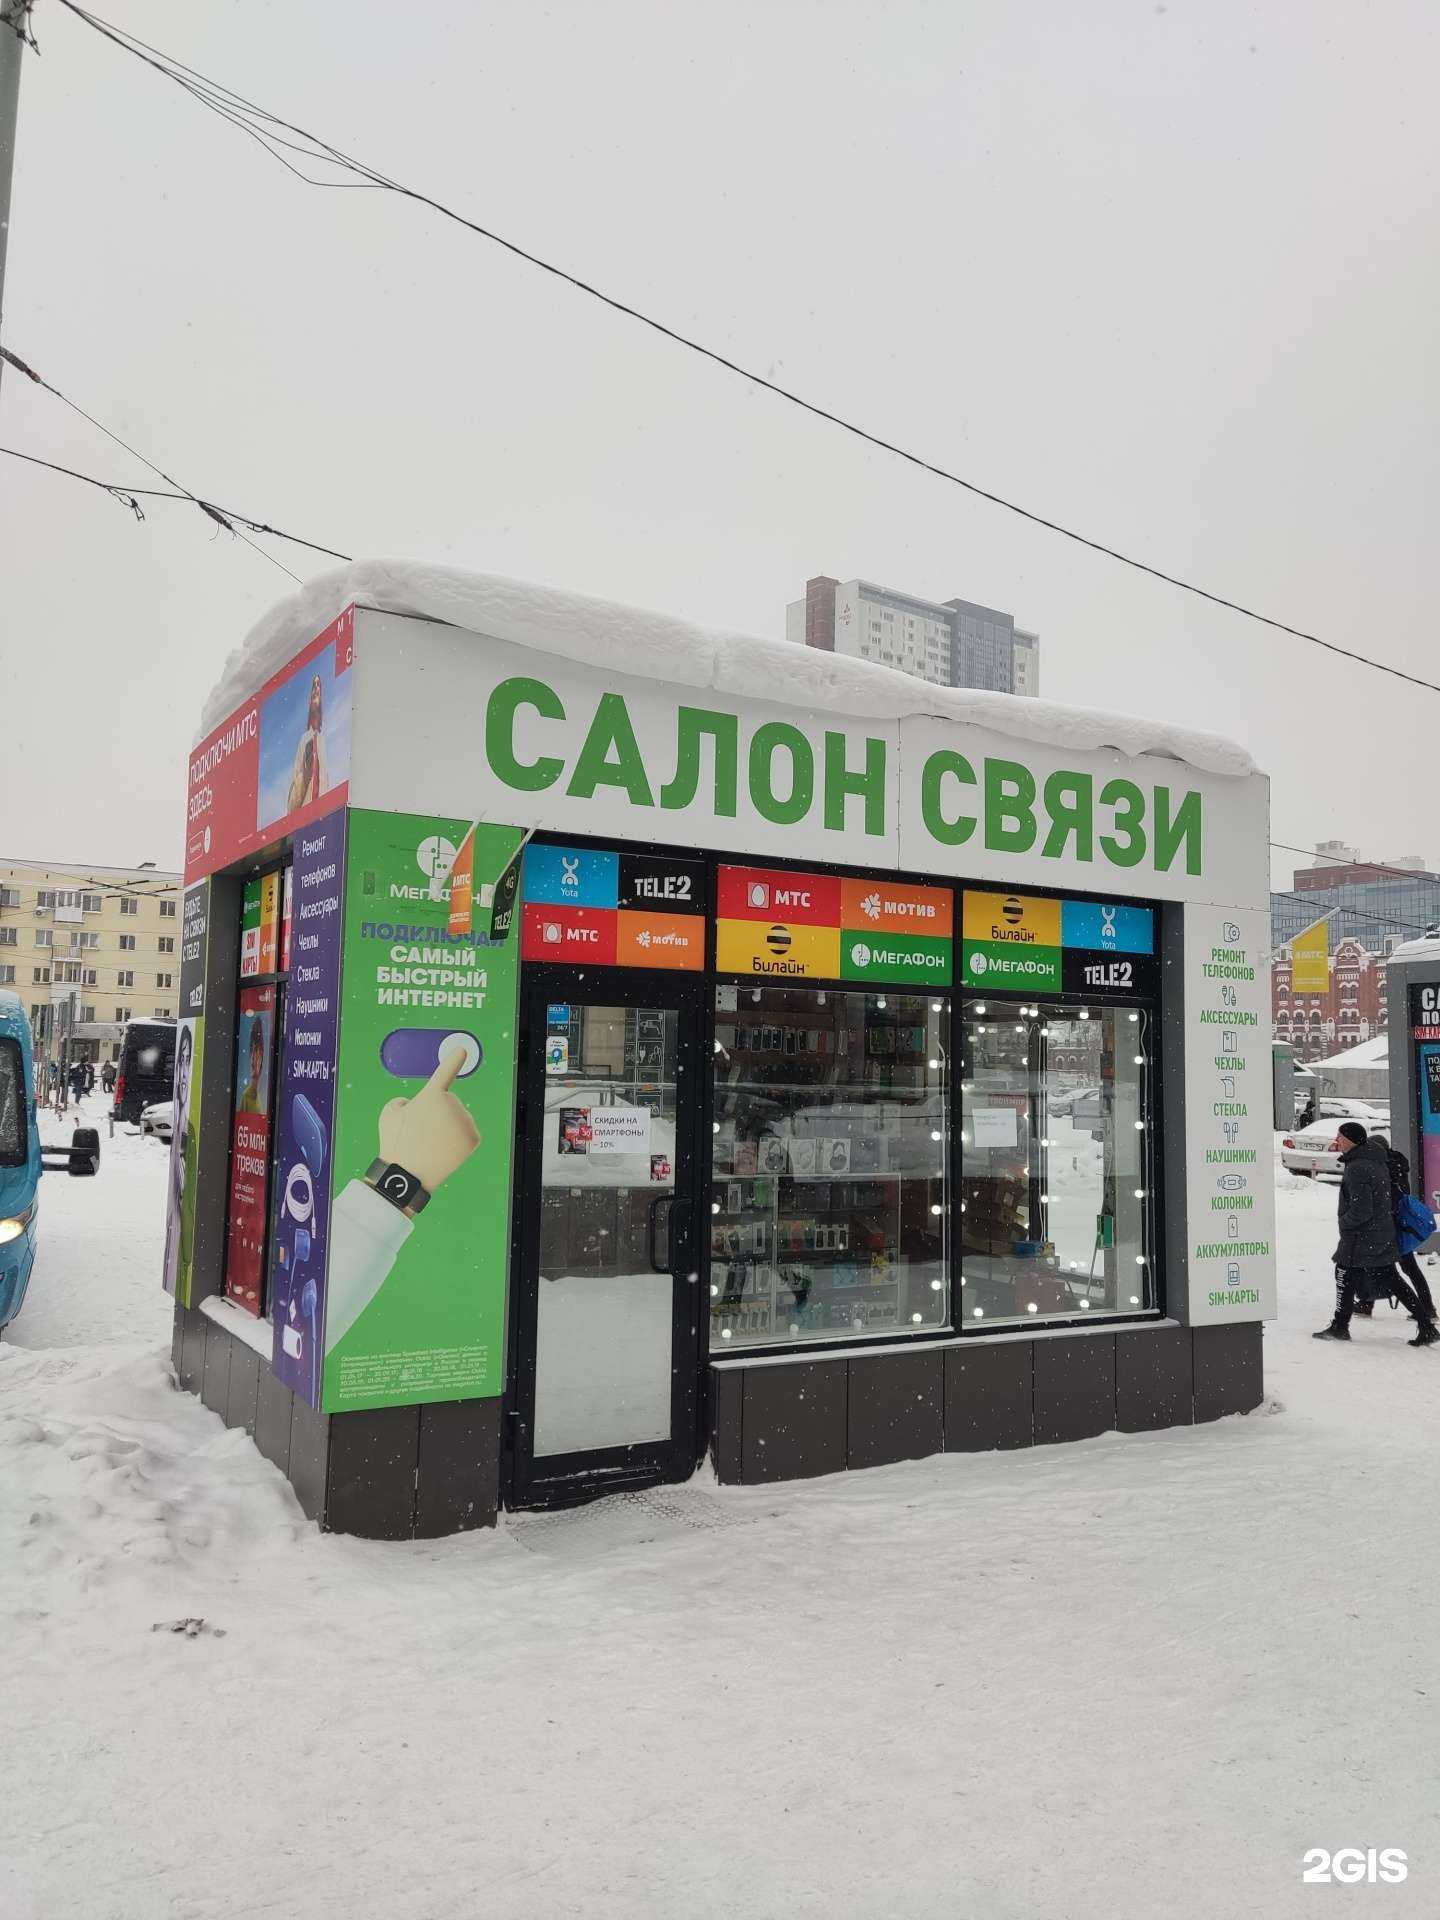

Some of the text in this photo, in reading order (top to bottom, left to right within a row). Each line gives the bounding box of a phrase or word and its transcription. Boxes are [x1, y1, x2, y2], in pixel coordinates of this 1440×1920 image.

[190, 709, 257, 785] ПОДКЛЮЧИ МТС
[485, 676, 1202, 876] САЛОН СВЯЗИ
[189, 784, 212, 820] ЗДЕСЬ
[302, 836, 327, 858] Ремонт
[300, 864, 336, 888] телефонов
[505, 875, 515, 889] 4G
[560, 887, 578, 898] Yota
[634, 875, 692, 900] TELE2
[775, 889, 811, 908] МТС
[299, 896, 339, 920] Аксессуары
[494, 911, 512, 930] TELE2
[298, 934, 319, 951] Чехлы
[566, 928, 599, 942] МТС
[991, 925, 1035, 943] Билайн
[1101, 939, 1116, 951] Yota
[390, 945, 476, 966] САМЫЙ
[1211, 948, 1246, 964] РЕМОНТ
[297, 965, 320, 982] Стекла
[752, 956, 805, 974] Билайн
[1202, 964, 1255, 981] ТЕЛЕФОНОВ
[376, 966, 488, 988] БЫСТРЫЙ
[1084, 962, 1133, 988] TELE2
[295, 997, 328, 1018] Наушники
[377, 988, 486, 1009] ИНТЕРНЕТ
[1421, 987, 1440, 1010] С
[1200, 1010, 1258, 1026] АКСЕССУАРЫ
[294, 1028, 321, 1046] Колонки
[293, 1060, 329, 1080] SIM-КАРТЫ
[1214, 1057, 1246, 1071] ЧЕХЛЫ
[1213, 1102, 1247, 1117] СТЕКЛА
[594, 1117, 638, 1126] СКИДКИ НА
[237, 1125, 266, 1152] 65 млн
[594, 1128, 644, 1137] СМАРТФОНЫ
[236, 1153, 265, 1178] треков
[1206, 1149, 1257, 1164] НАУШНИКИ
[1211, 1196, 1253, 1210] КОЛОНКИ
[1196, 1241, 1269, 1259] АККУМУЛЯТОРЫ
[1208, 1289, 1260, 1306] SIM-КАРТЫ
